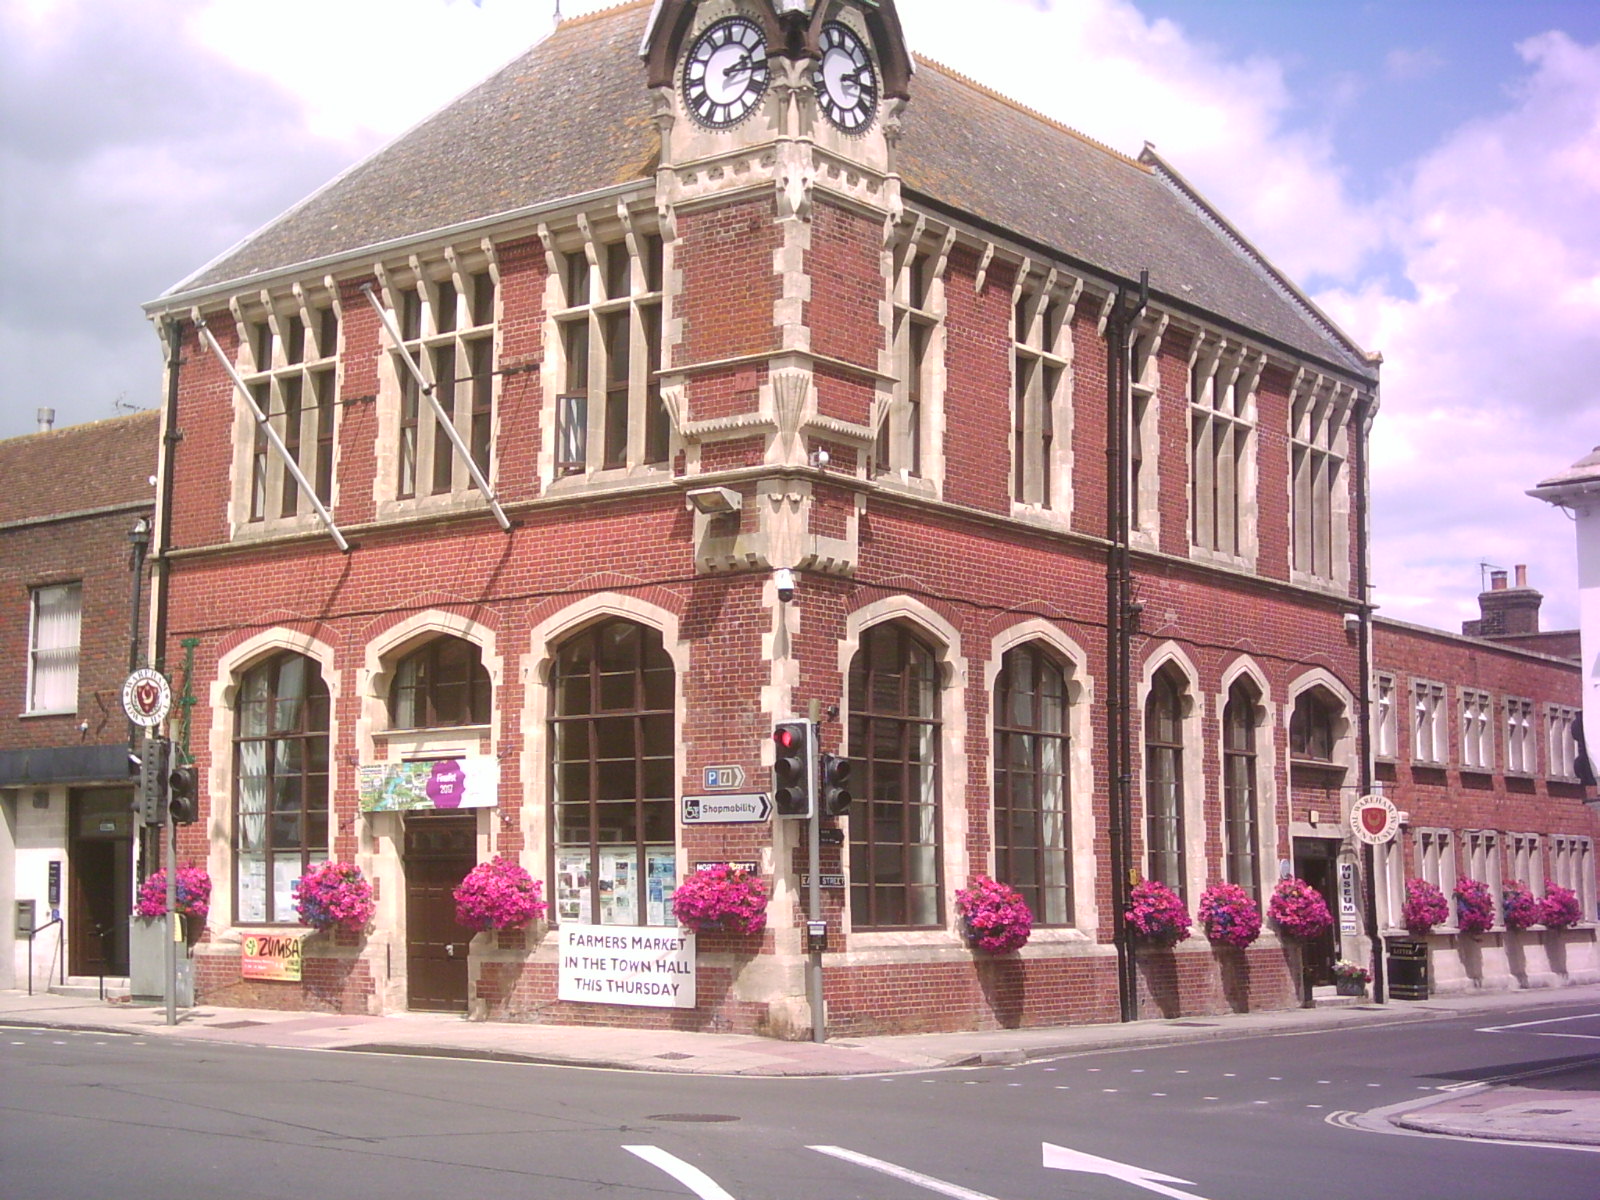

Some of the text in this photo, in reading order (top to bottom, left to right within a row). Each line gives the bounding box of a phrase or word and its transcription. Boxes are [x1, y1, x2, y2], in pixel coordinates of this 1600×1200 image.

[126, 670, 169, 691] WAREHAM
[708, 771, 717, 785] P
[440, 784, 454, 794] 2017
[702, 803, 757, 814] Shopmobility
[1354, 797, 1395, 814] WAREHAM
[696, 863, 723, 872] NOR
[1341, 865, 1353, 911] MUSEUM
[258, 936, 301, 959] ZUMBA
[569, 933, 686, 950] FARMERS MARKET
[564, 956, 691, 974] IN THE TOWN HALL
[574, 978, 680, 997] THIS THURSDAY
